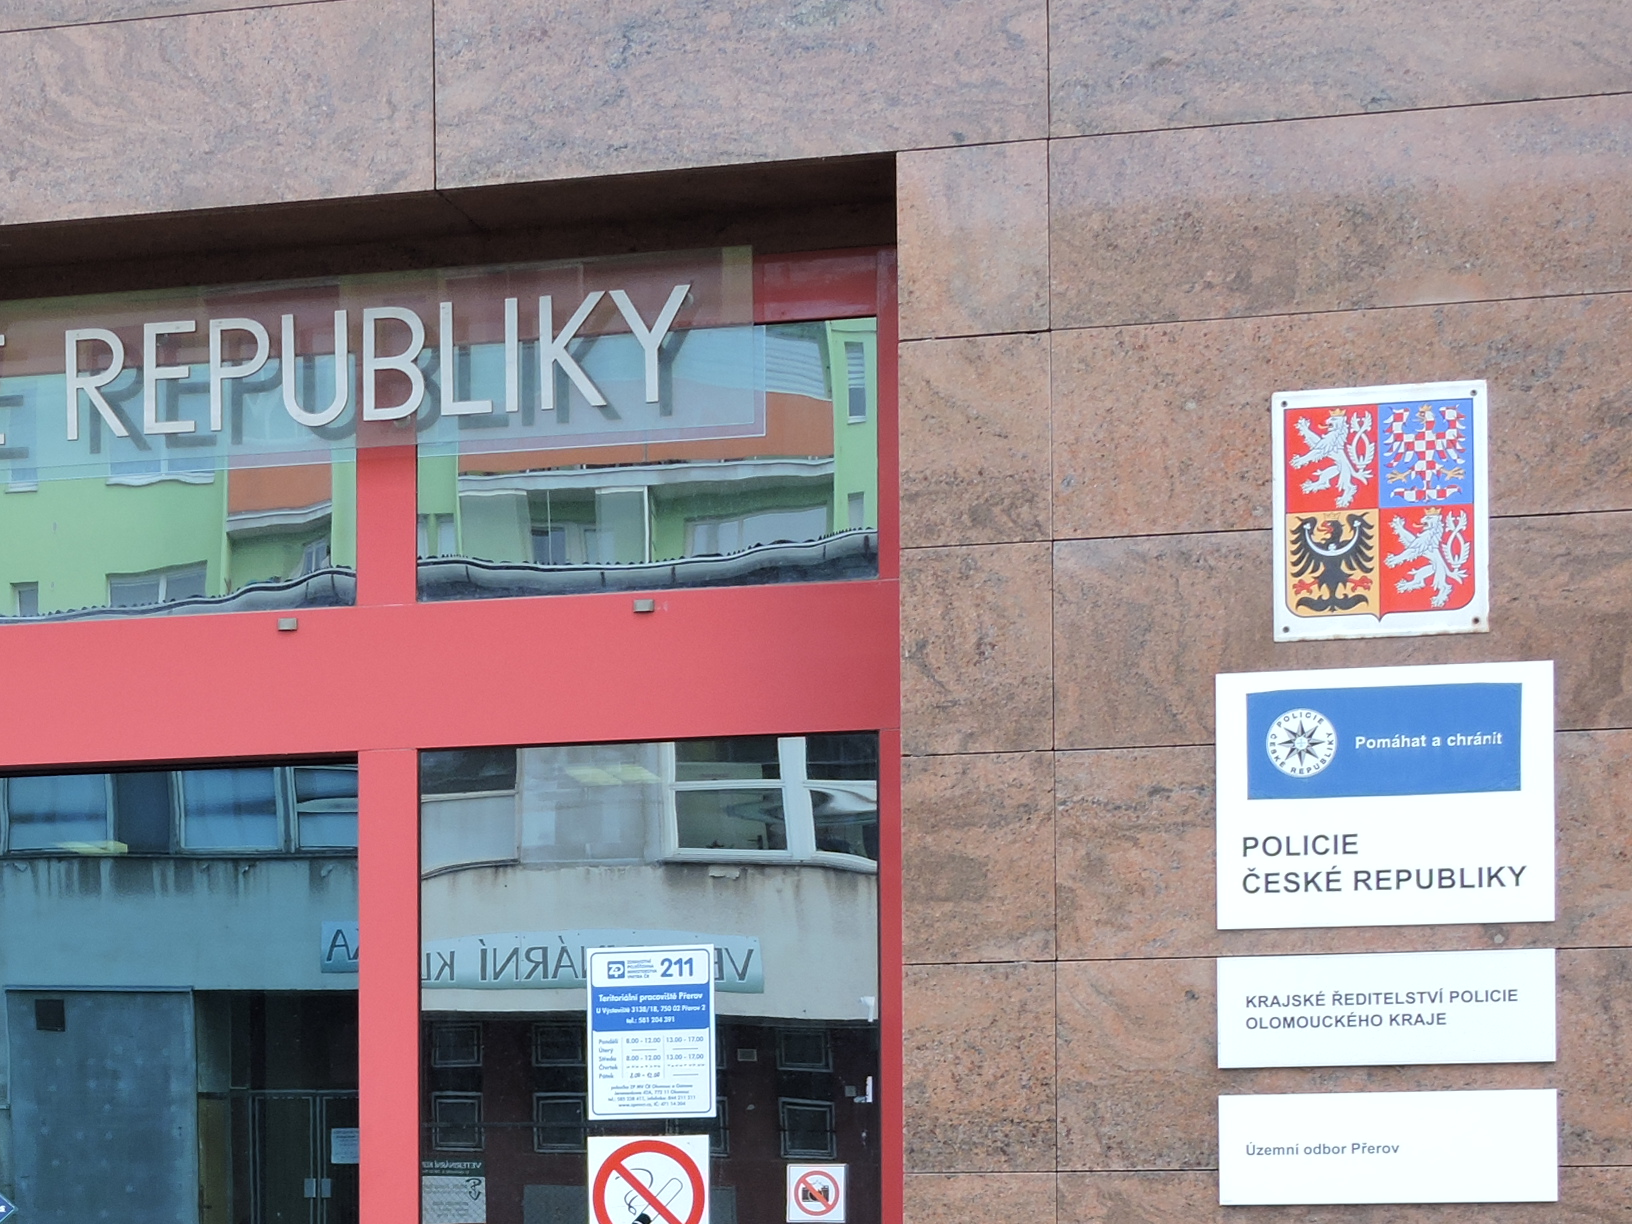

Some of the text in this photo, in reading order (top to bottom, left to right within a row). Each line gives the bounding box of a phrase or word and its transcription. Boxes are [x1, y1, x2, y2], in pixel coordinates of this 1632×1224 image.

[64, 284, 691, 442] REPUBLIKY
[1276, 711, 1325, 729] POLICIE
[1354, 731, 1503, 749] Pomáhat a chránit
[1290, 732, 1335, 775] REPUBLIKY
[1242, 833, 1359, 858] POLICIE
[1241, 865, 1527, 895] ČESKÉ REPUBLIKY
[660, 957, 694, 978] 211
[598, 991, 704, 1003] Teritoriální pracoviště Přerov
[1245, 987, 1519, 1009] KRAJSKÉ ŘEDITELSTVÍ POLICIE
[681, 1004, 701, 1012] Přerov
[1245, 1011, 1448, 1030] OLOMOUCKÉHO KRAJE
[1245, 1141, 1400, 1156] Územní odbor Přerov
